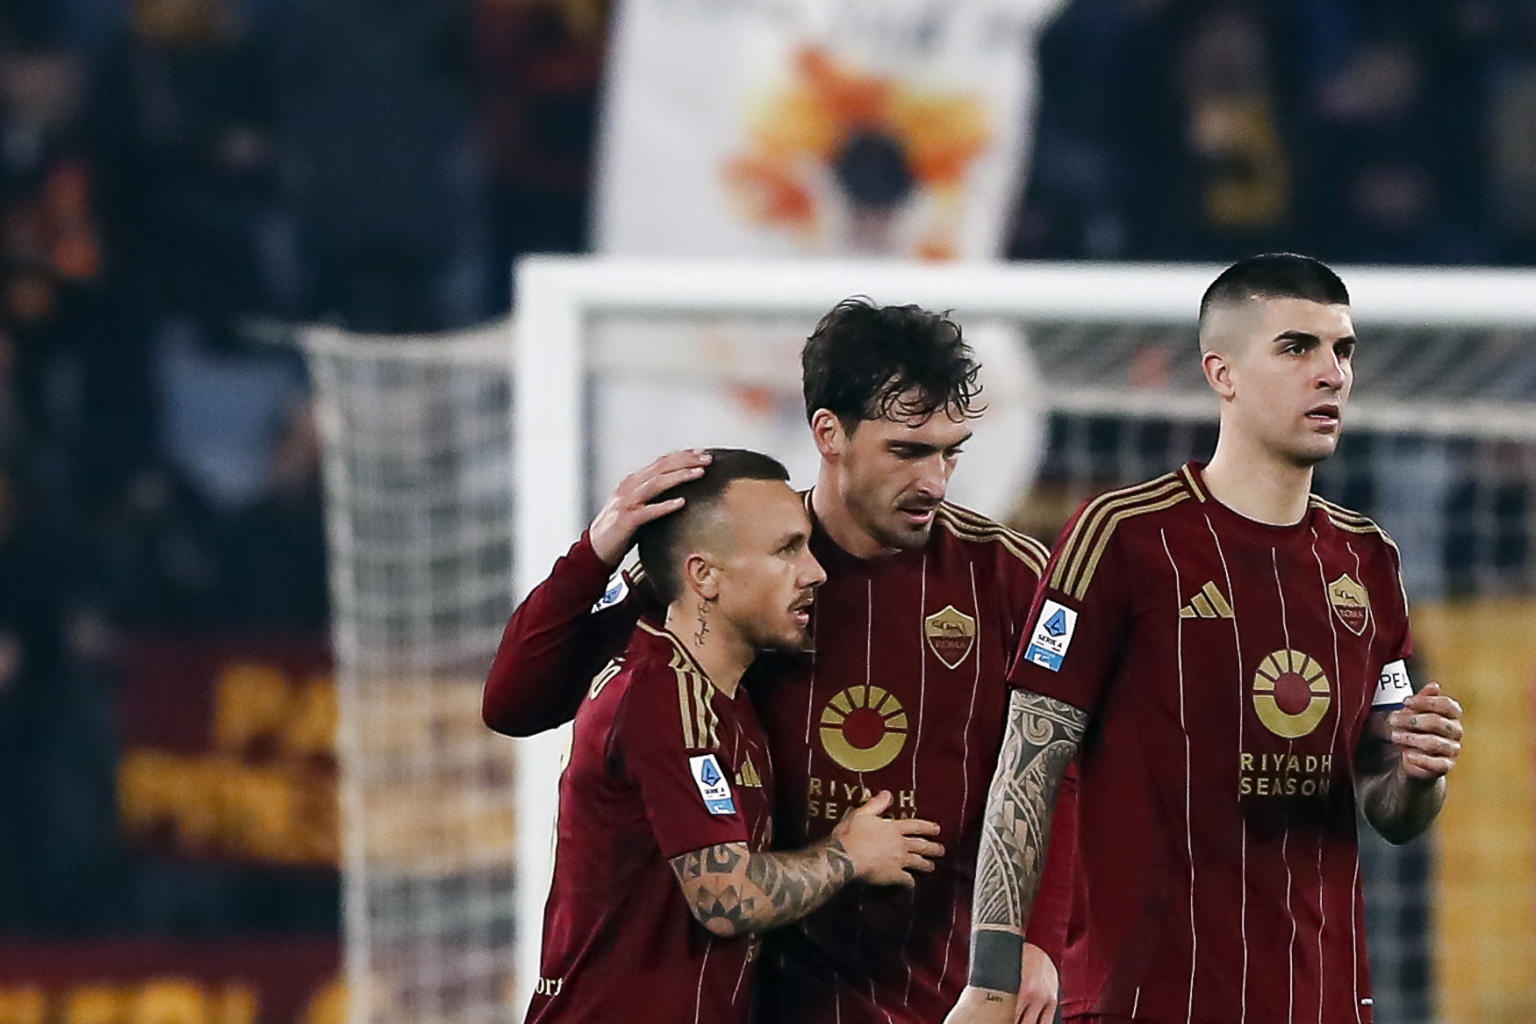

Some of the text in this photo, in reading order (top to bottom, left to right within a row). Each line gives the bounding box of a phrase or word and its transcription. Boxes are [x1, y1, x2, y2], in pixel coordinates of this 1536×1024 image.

[1240, 753, 1332, 773] RIYADH
[808, 777, 915, 808] RIYAH
[1240, 777, 1331, 796] SEASON
